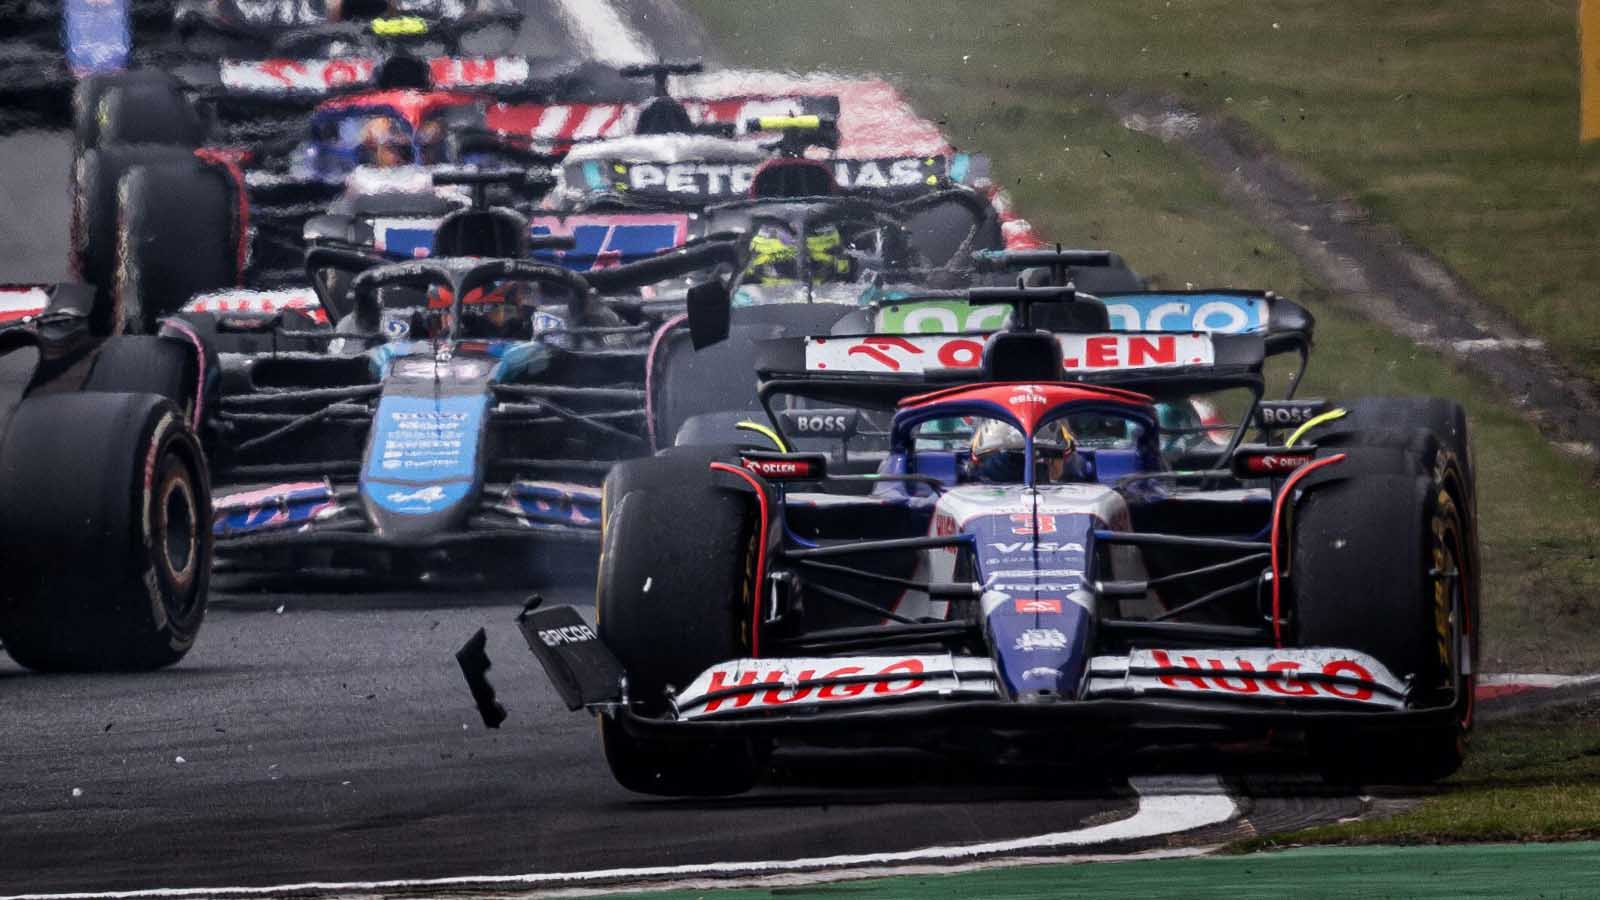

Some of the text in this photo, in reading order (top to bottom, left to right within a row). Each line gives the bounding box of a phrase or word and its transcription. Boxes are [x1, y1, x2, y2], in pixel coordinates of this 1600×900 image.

[937, 335, 1177, 370] OEN
[797, 415, 846, 432] BOSS
[762, 463, 797, 473] ORLEN
[1010, 515, 1056, 535] 3
[986, 542, 1086, 553] VISA
[703, 658, 925, 713] HUGO
[1150, 649, 1377, 702] HUGO
